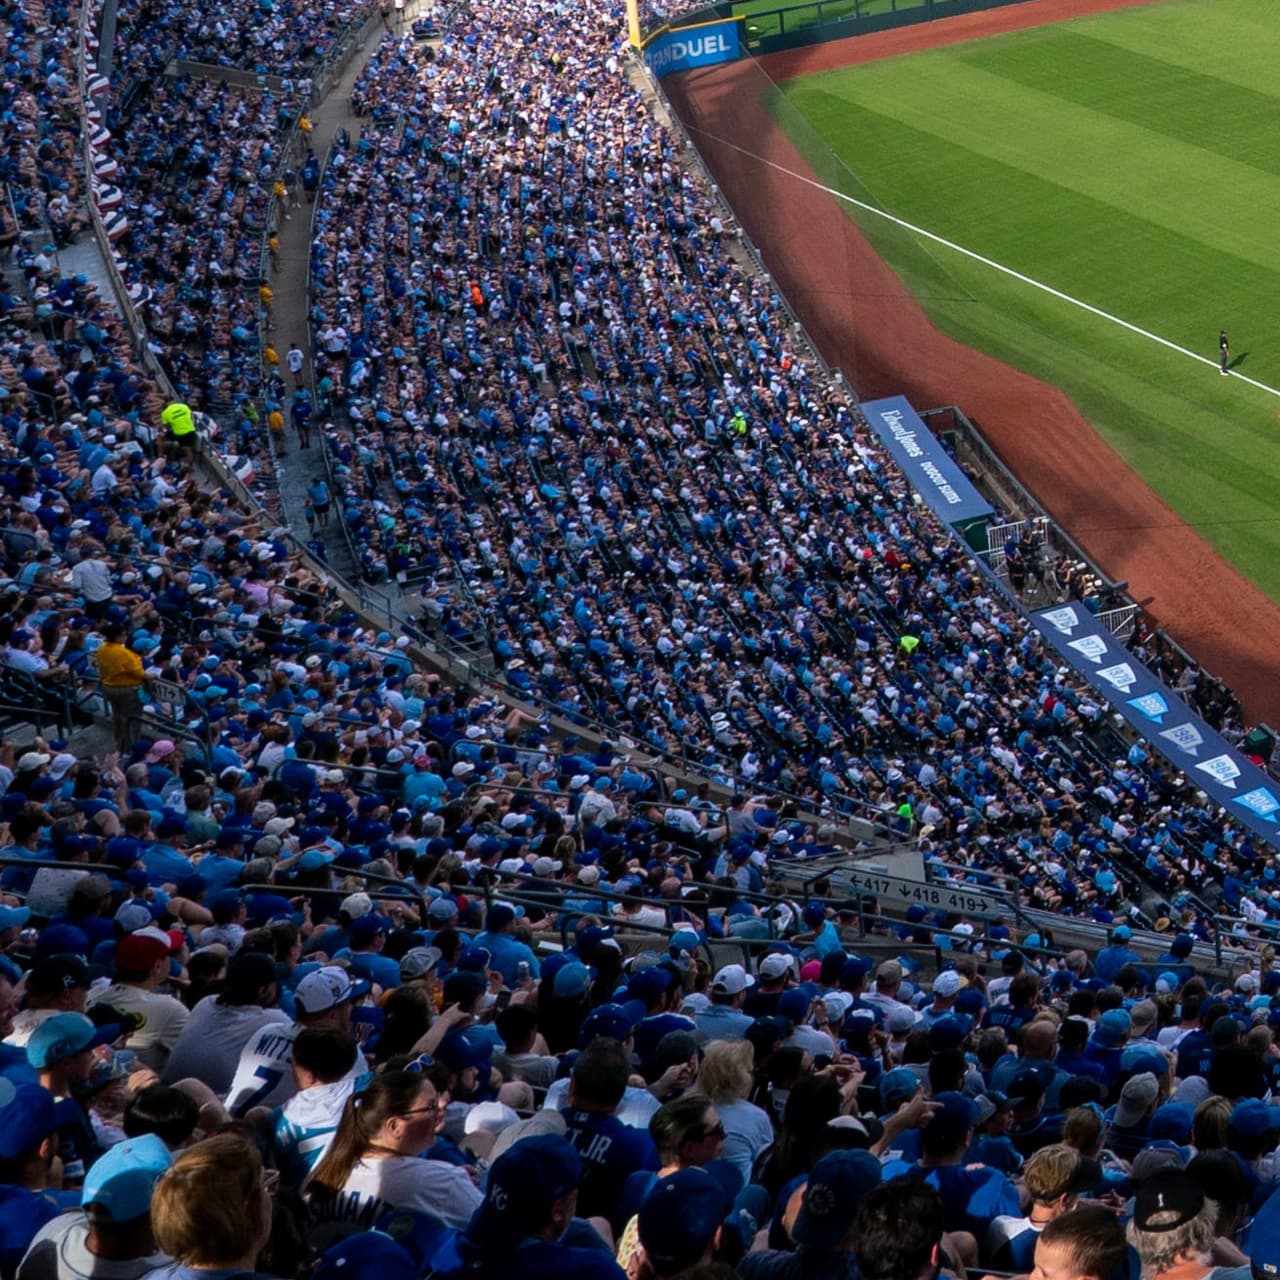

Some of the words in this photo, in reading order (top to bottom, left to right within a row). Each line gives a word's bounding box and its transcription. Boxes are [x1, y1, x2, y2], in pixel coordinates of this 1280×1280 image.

[651, 33, 732, 71] FANDUEL
[1244, 791, 1276, 812] 2014
[863, 877, 890, 893] 417
[912, 888, 940, 904] 418
[949, 896, 976, 912] 419
